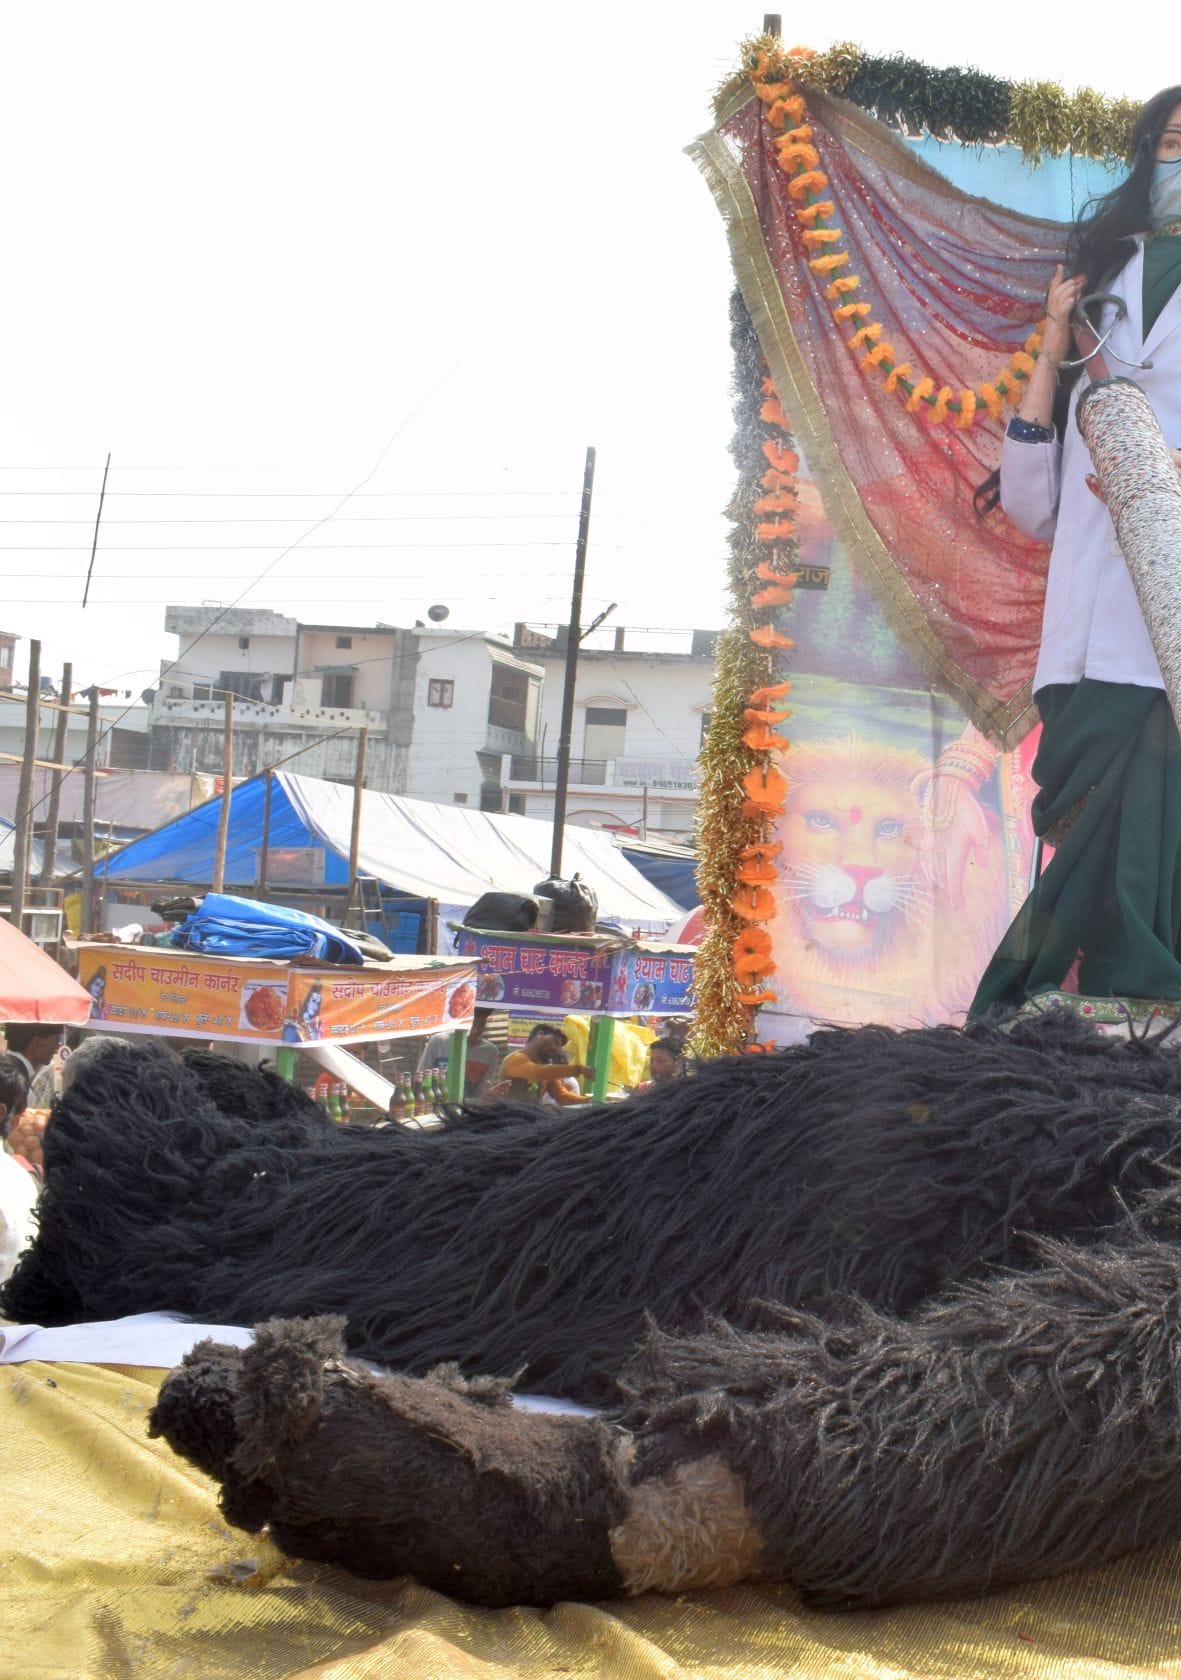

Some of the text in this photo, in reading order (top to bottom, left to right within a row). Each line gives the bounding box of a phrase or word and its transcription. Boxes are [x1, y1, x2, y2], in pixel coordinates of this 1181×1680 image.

[520, 947, 546, 975] चाट
[633, 955, 691, 983] श्याम चाट
[112, 959, 240, 993] संदीप चाउमीन कार्नर
[331, 976, 365, 999] संदीप
